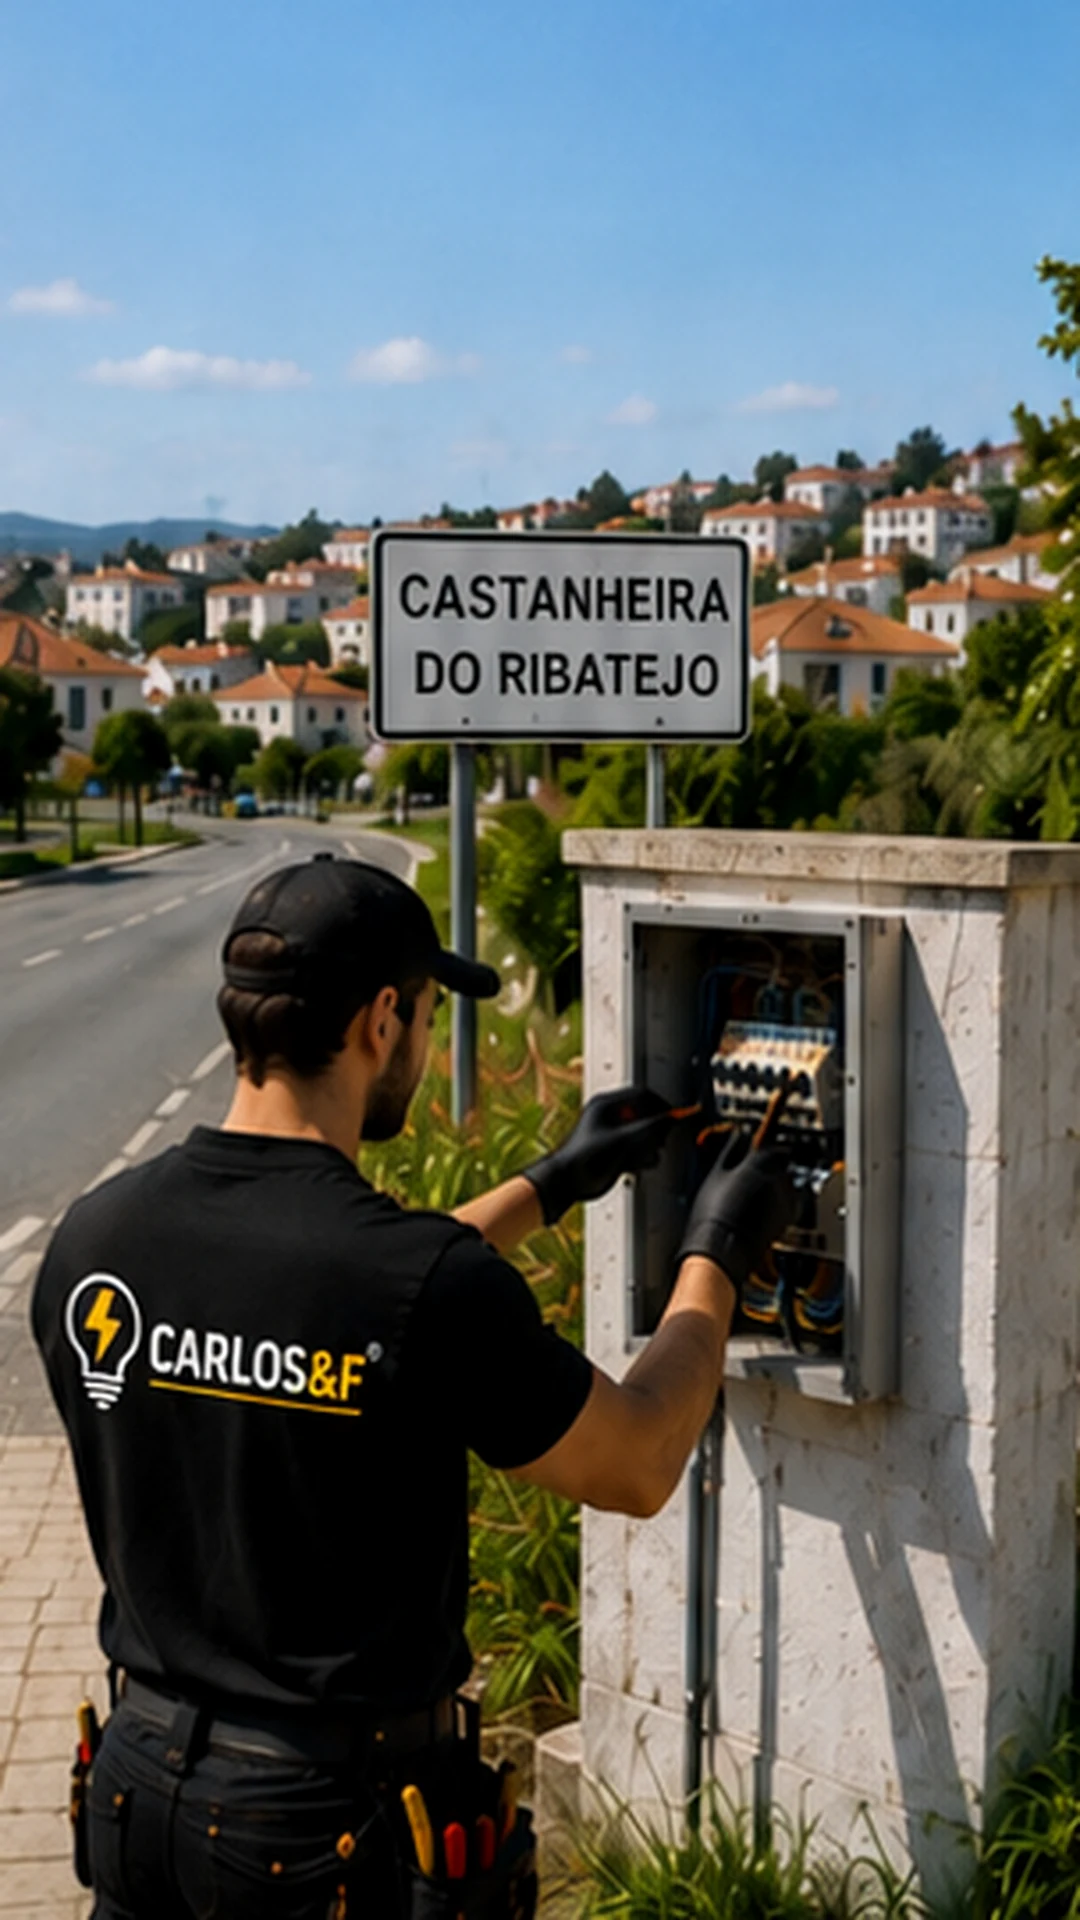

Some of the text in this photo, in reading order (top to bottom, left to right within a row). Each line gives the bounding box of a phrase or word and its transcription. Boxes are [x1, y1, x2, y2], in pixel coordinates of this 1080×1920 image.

[400, 574, 730, 622] CASTANHEIRA
[415, 651, 719, 697] DO RIBATEJO
